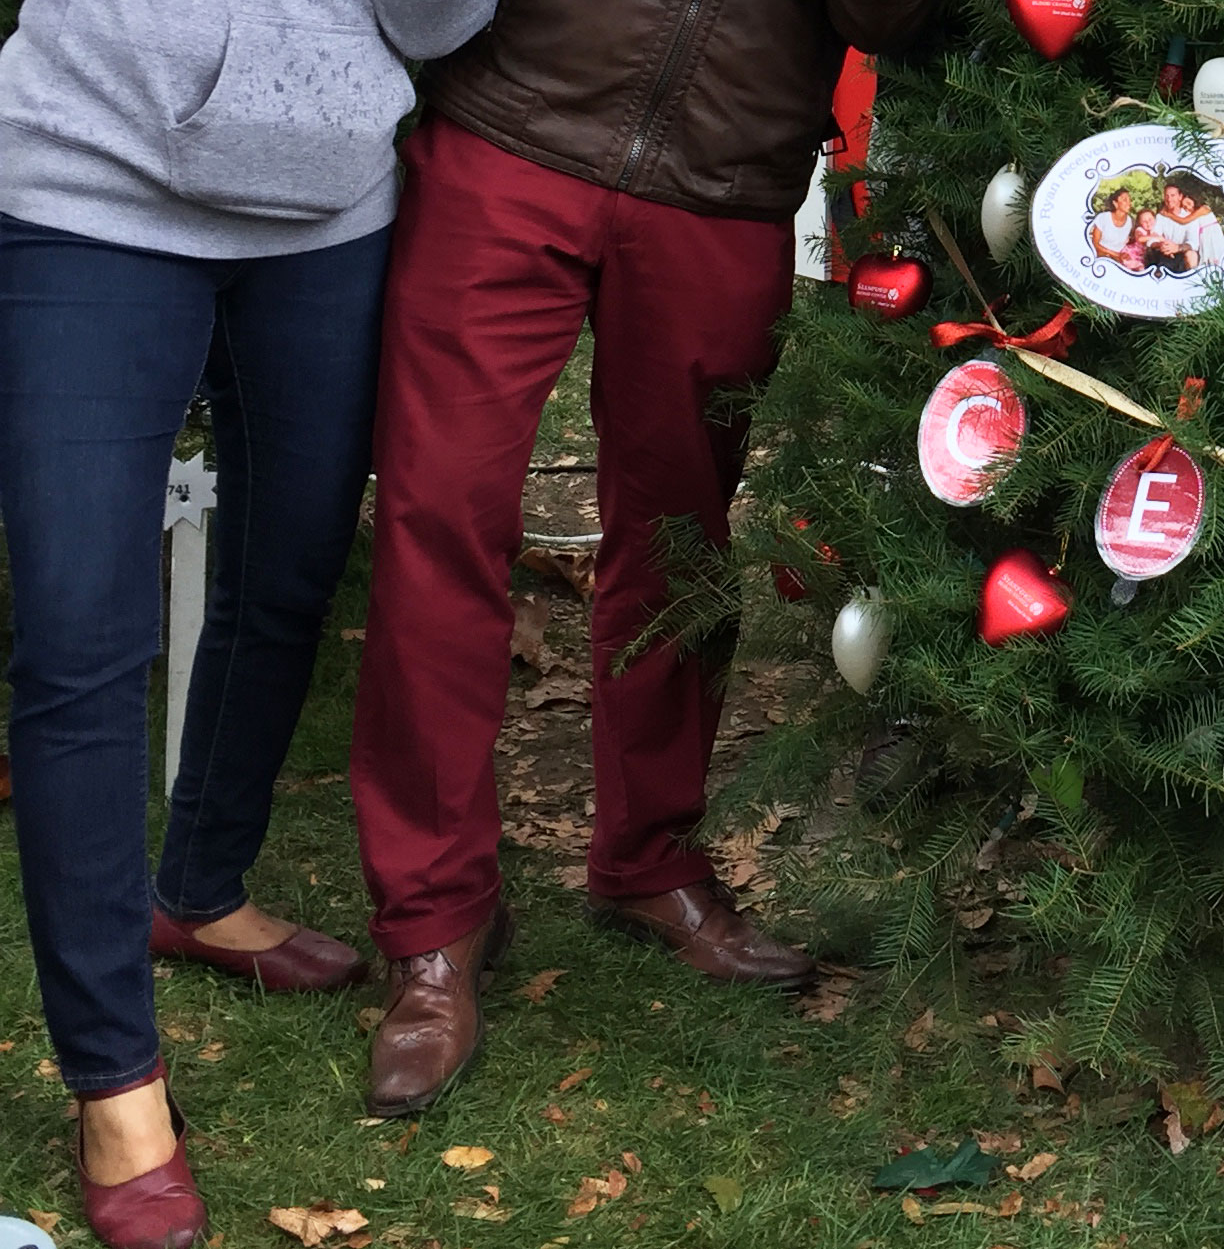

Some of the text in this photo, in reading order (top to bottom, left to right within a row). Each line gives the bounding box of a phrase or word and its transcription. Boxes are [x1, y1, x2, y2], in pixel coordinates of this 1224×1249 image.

[1039, 181, 1060, 220] Ryan
[1059, 142, 1109, 187] received
[1113, 137, 1131, 151] an
[1135, 134, 1175, 149] emer
[1082, 275, 1102, 292] an
[1103, 288, 1116, 303] in
[1120, 293, 1160, 311] blood
[945, 395, 1003, 471] C
[1125, 472, 1178, 543] E
[168, 483, 191, 496] 741
